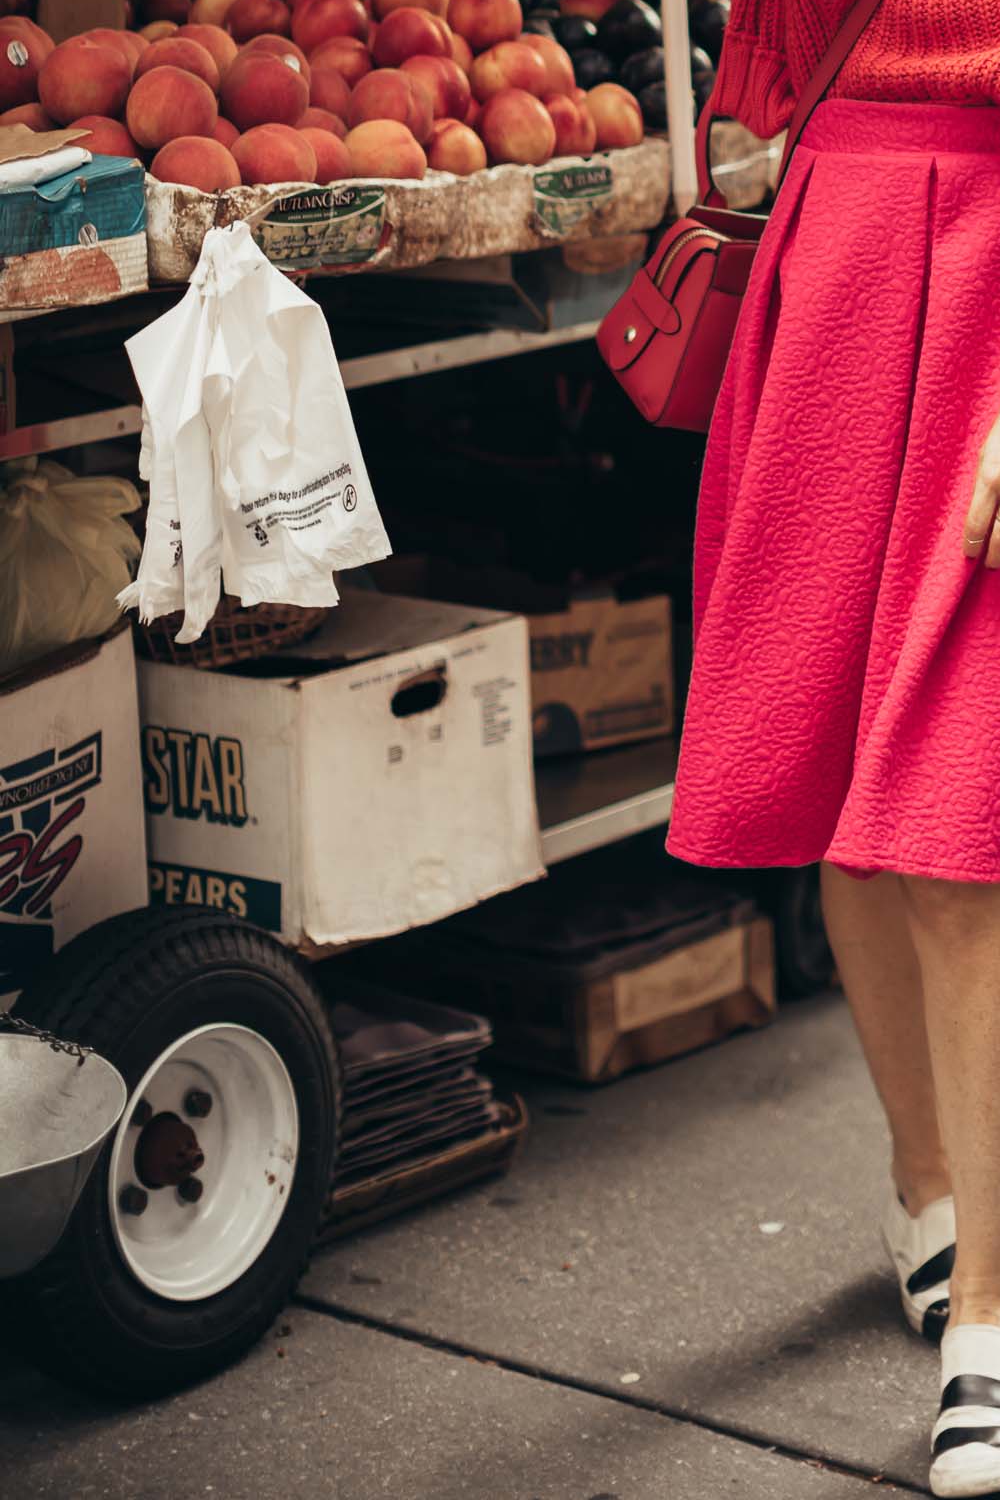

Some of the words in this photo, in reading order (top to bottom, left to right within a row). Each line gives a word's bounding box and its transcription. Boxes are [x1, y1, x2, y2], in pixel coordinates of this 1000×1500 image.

[278, 491, 291, 503] bag
[144, 724, 249, 829] STAR
[149, 865, 248, 918] PEARS
